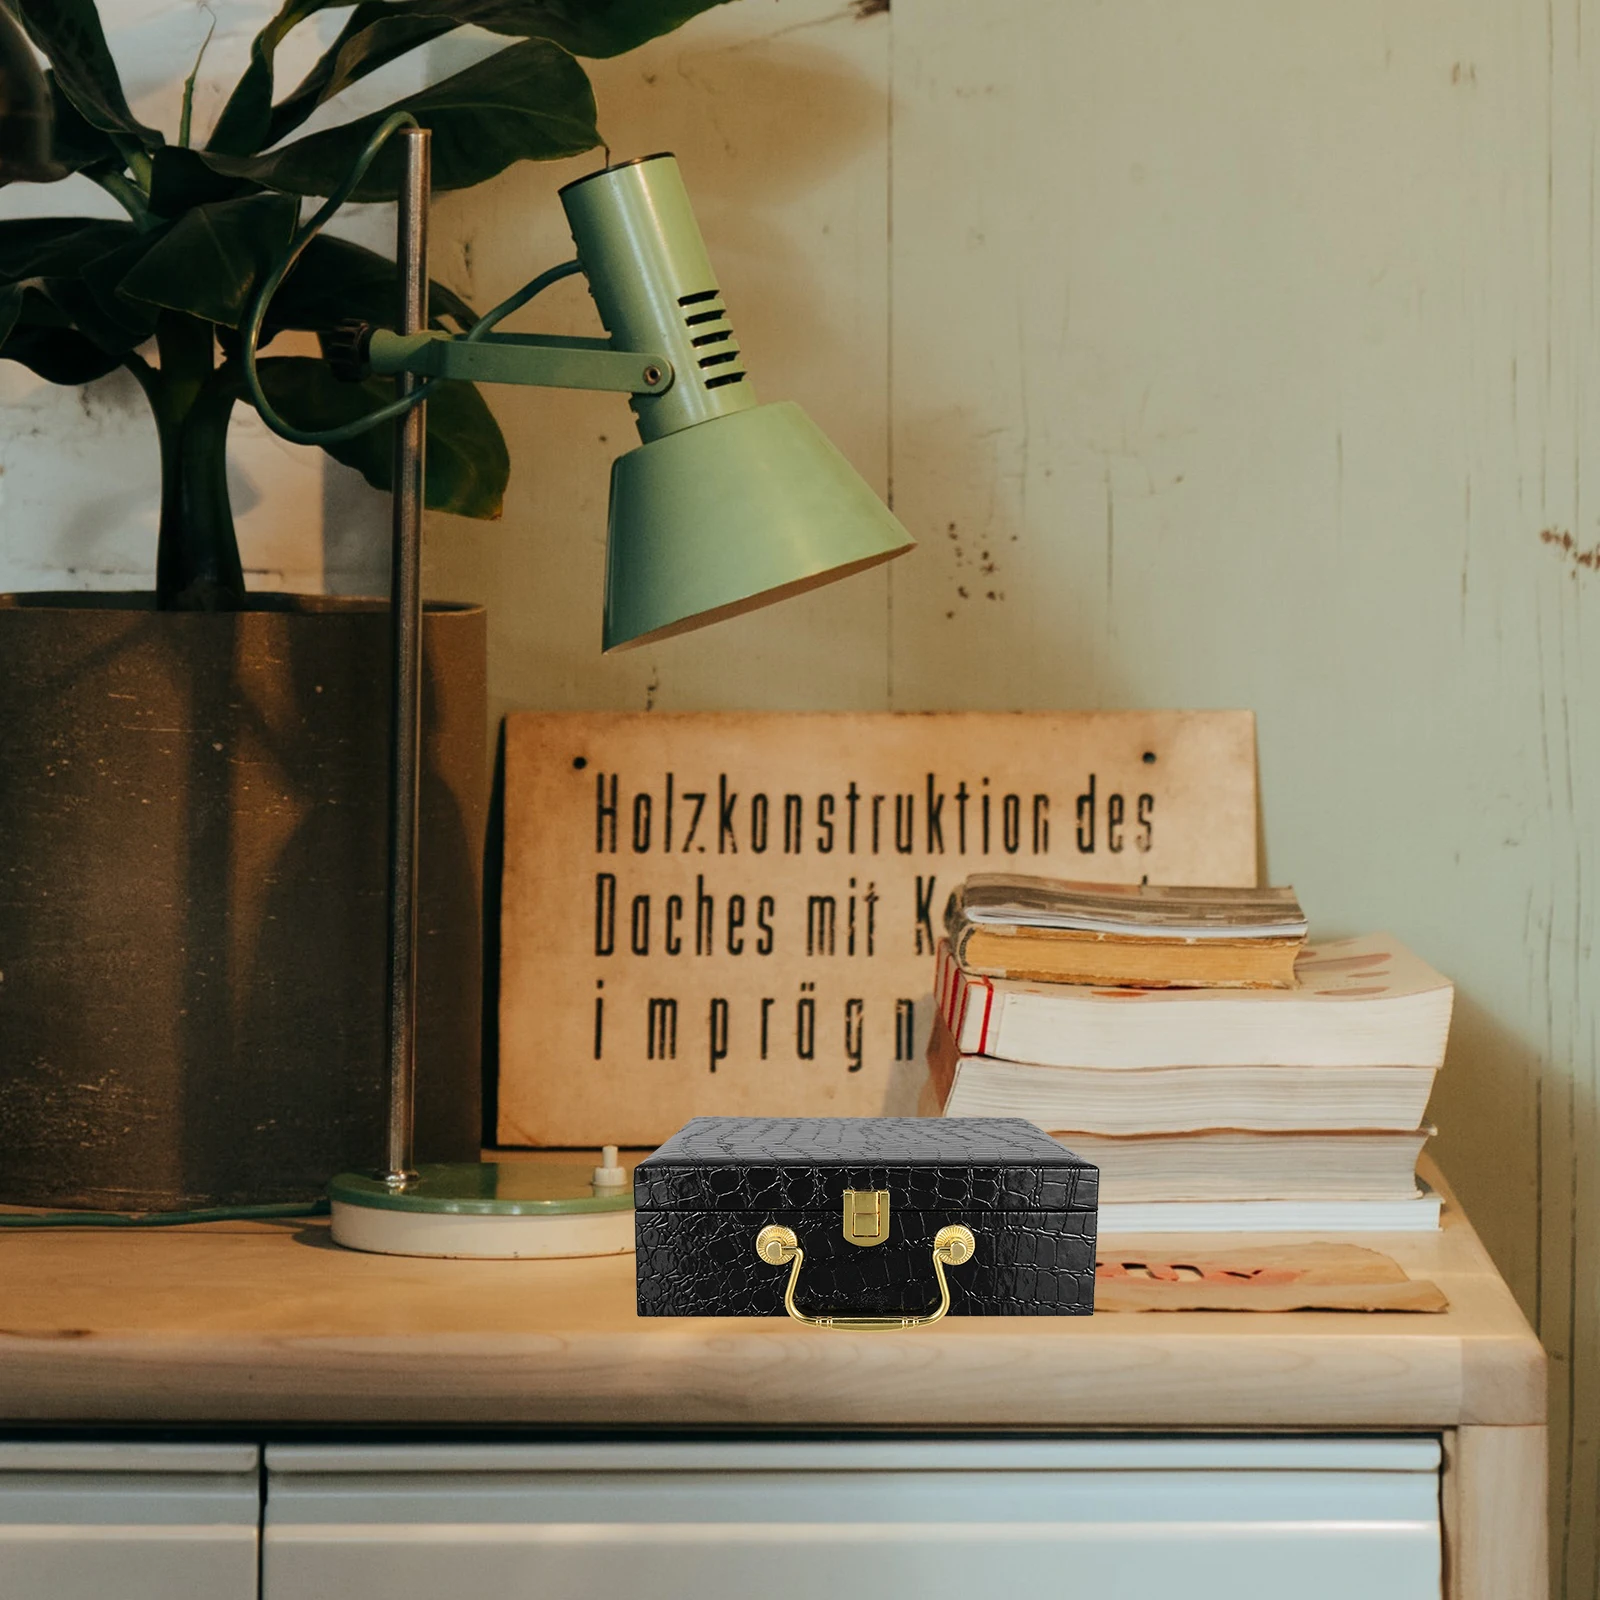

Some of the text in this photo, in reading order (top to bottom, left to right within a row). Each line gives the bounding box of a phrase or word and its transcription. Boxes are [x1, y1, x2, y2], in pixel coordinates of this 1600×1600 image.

[595, 772, 1154, 855] Holzkonstruktion des
[594, 872, 775, 957] Daches
[807, 877, 880, 957] mit
[594, 979, 915, 1073] imprägn
